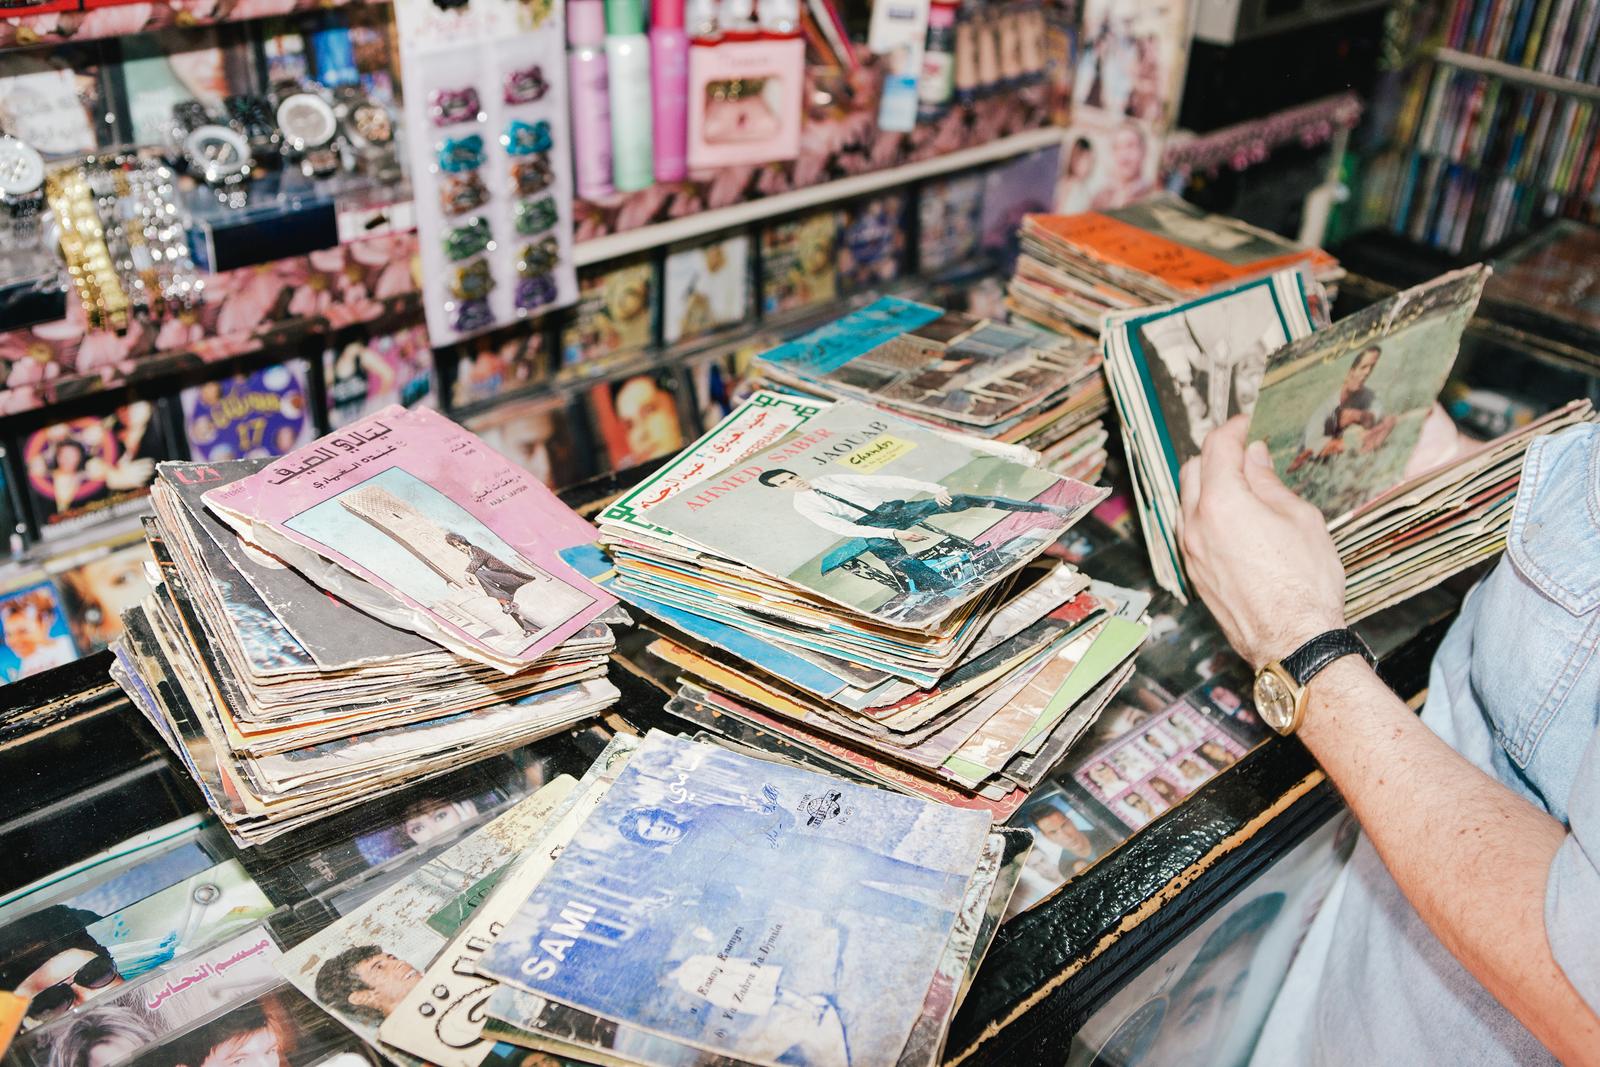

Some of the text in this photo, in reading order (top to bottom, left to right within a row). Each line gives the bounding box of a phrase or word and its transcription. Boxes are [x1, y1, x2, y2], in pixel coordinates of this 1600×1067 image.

[267, 421, 393, 485] ليالي الصيف
[686, 464, 764, 512] AHMED
[767, 427, 833, 463] SABER
[812, 421, 888, 465] JAOUAB
[147, 939, 270, 1009] ميسم النحاس
[521, 900, 598, 981] SAMI
